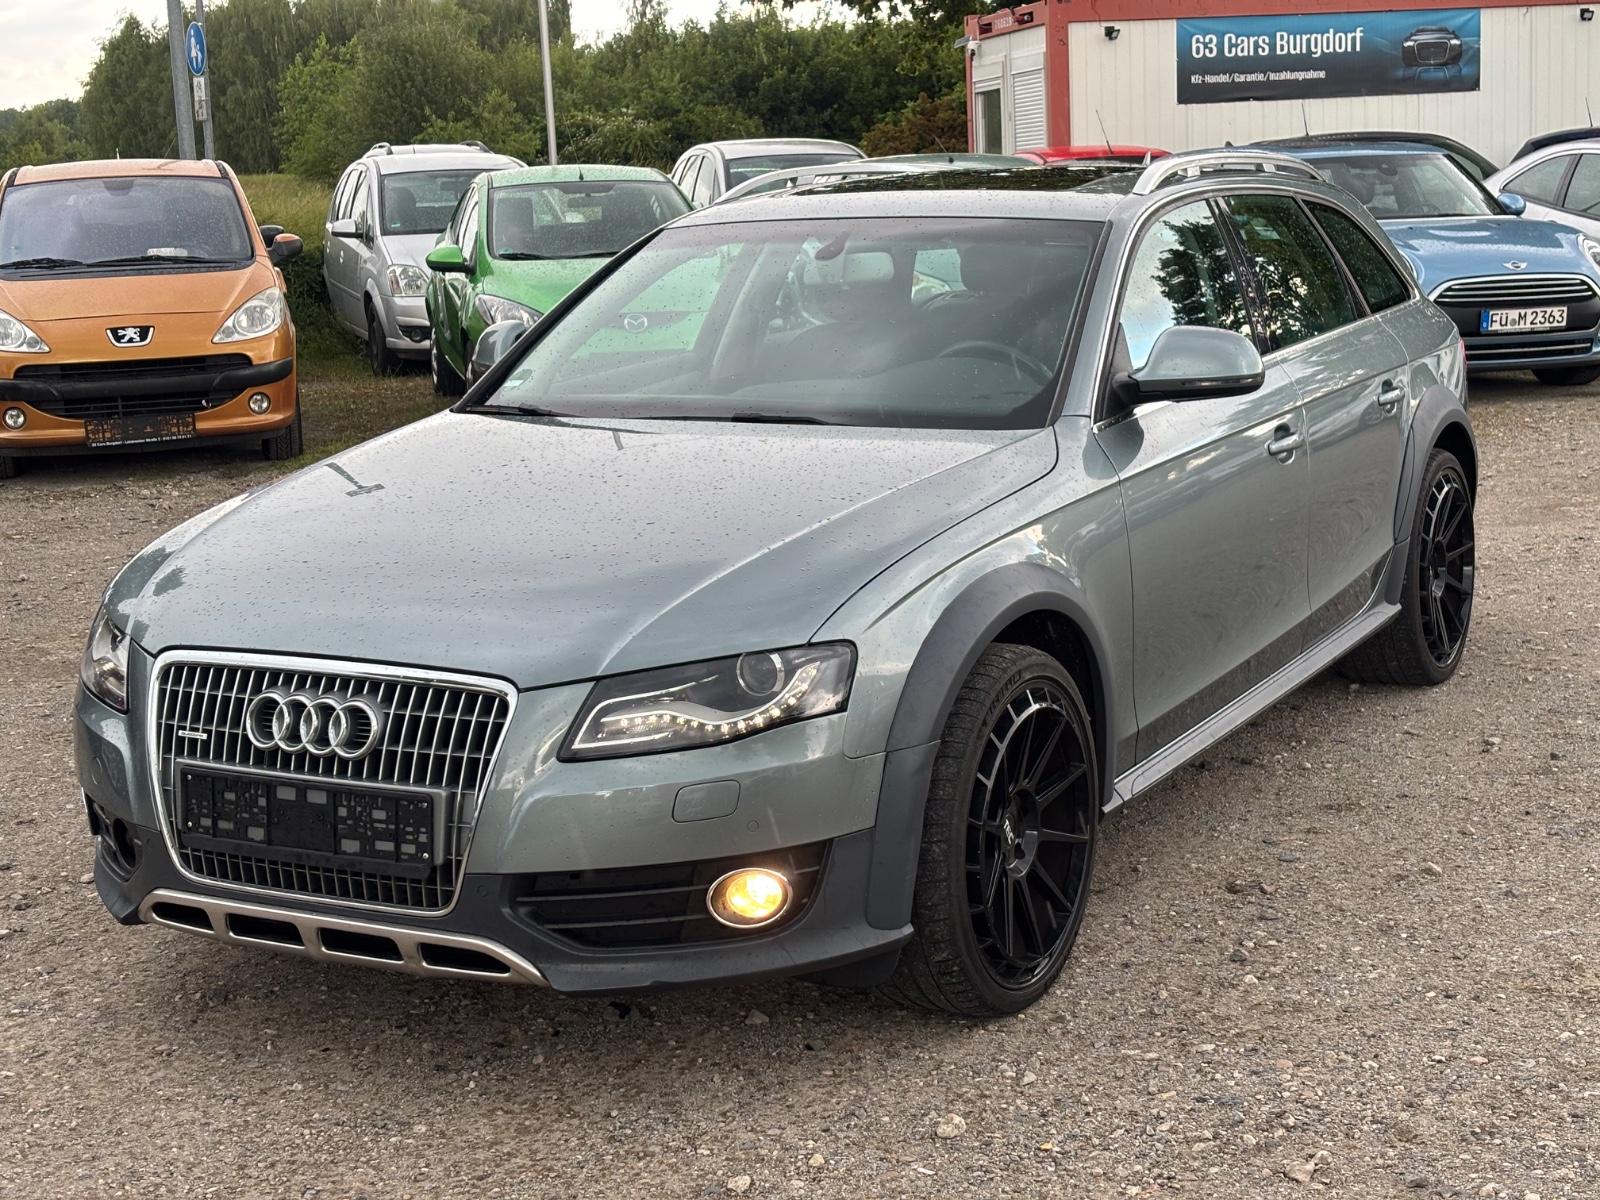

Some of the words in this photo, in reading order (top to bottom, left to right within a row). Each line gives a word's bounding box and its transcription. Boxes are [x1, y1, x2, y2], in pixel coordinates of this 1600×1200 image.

[1191, 34, 1217, 58] 63
[1223, 33, 1269, 57] Cars
[1275, 27, 1364, 58] Burgdorf
[1490, 312, 1508, 328] FÜ
